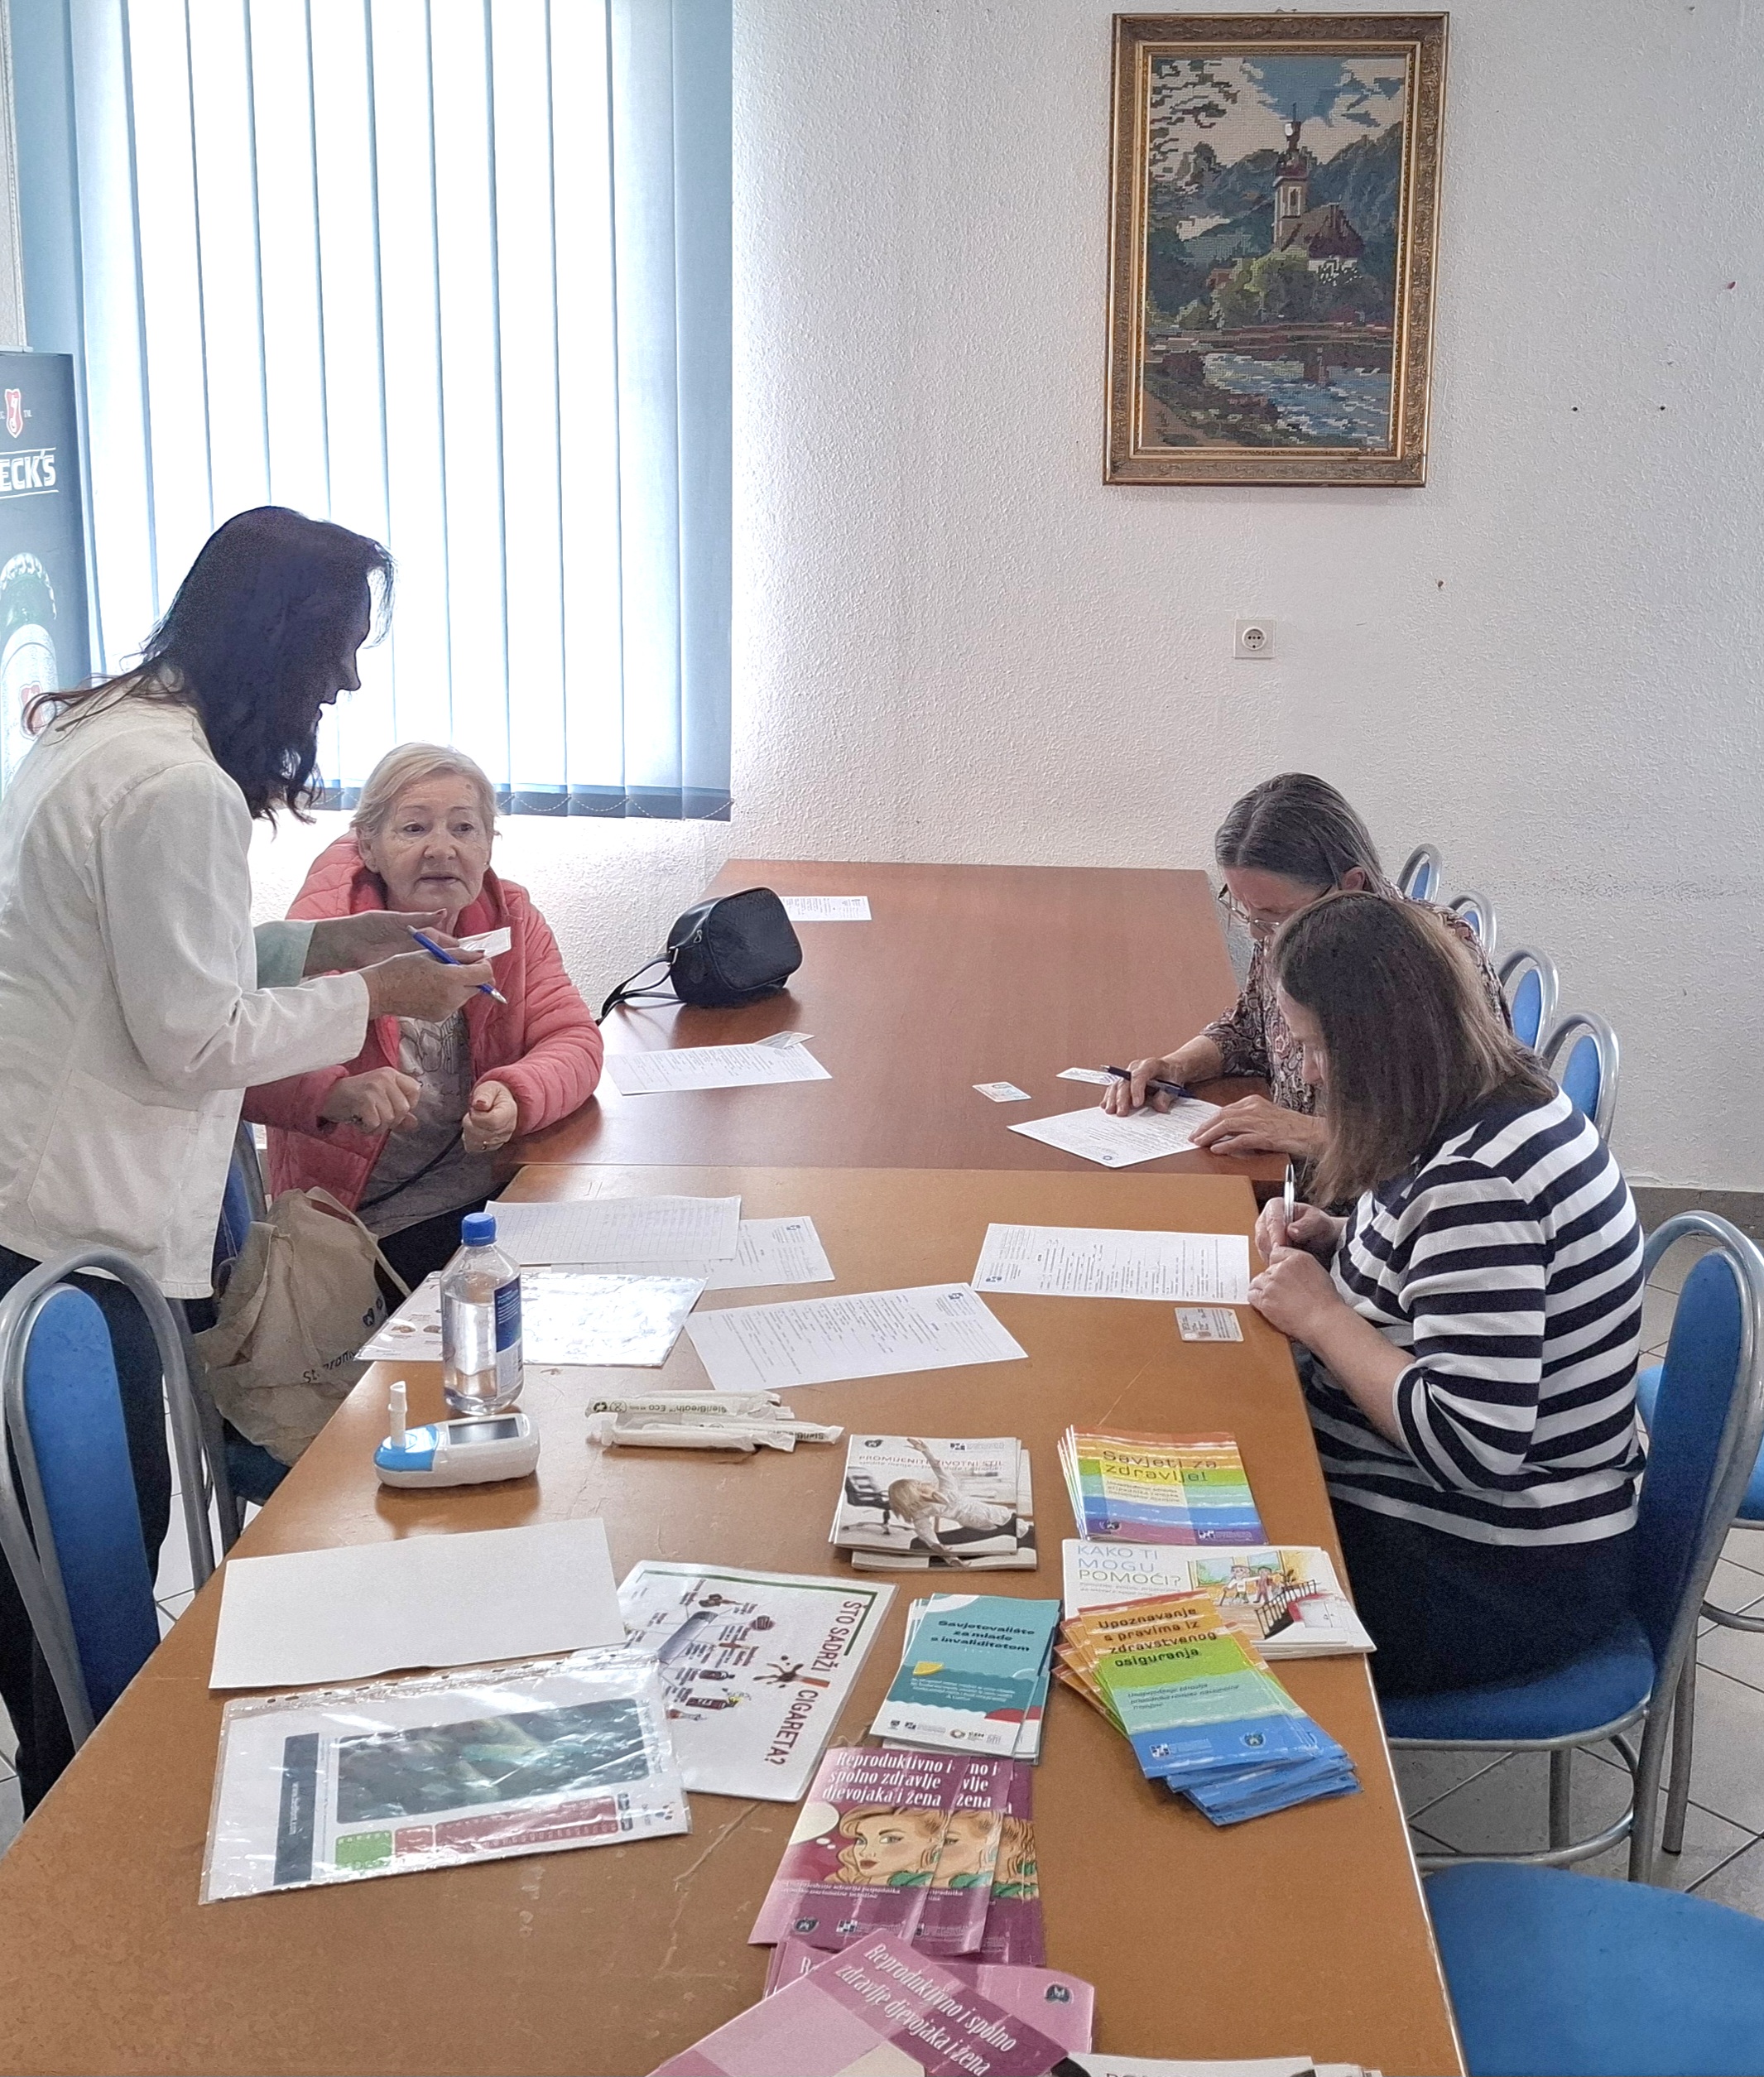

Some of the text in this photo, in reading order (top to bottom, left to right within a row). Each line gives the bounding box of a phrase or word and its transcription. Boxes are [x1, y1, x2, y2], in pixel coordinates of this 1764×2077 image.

[0, 450, 56, 491] ECK'S
[1103, 1450, 1217, 1469] Savjeti za
[1078, 1545, 1158, 1560] KAKO TI
[1079, 1558, 1154, 1573] MOGU
[1079, 1570, 1181, 1586] POMOĆI?
[1098, 1608, 1197, 1629] Upoznavanje
[971, 1632, 1013, 1641] mlade
[1118, 1624, 1181, 1642] pravima
[1185, 1620, 1199, 1630] iz
[941, 1636, 1030, 1652] invaliditetom
[1110, 1632, 1217, 1654] zdravstvenog
[1114, 1647, 1199, 1667] osiguranja
[764, 1600, 868, 1766] ŠTO SADRŽI CIGARETA?
[836, 1752, 943, 1773] Reproduktivno
[946, 1759, 953, 1774] i
[829, 1768, 941, 1791] spolno zdravlje
[962, 1776, 989, 1792] vlje
[822, 1785, 942, 1806] djevojaka i žena
[956, 1792, 992, 1808] žena
[835, 1964, 892, 2005] zdravlje
[863, 1943, 963, 2017] Reproduktivno
[884, 1998, 951, 2051] djevojaka
[957, 2007, 976, 2023] i
[965, 2016, 1017, 2052] spolno
[944, 2038, 964, 2055] i
[949, 2045, 991, 2076] žena
